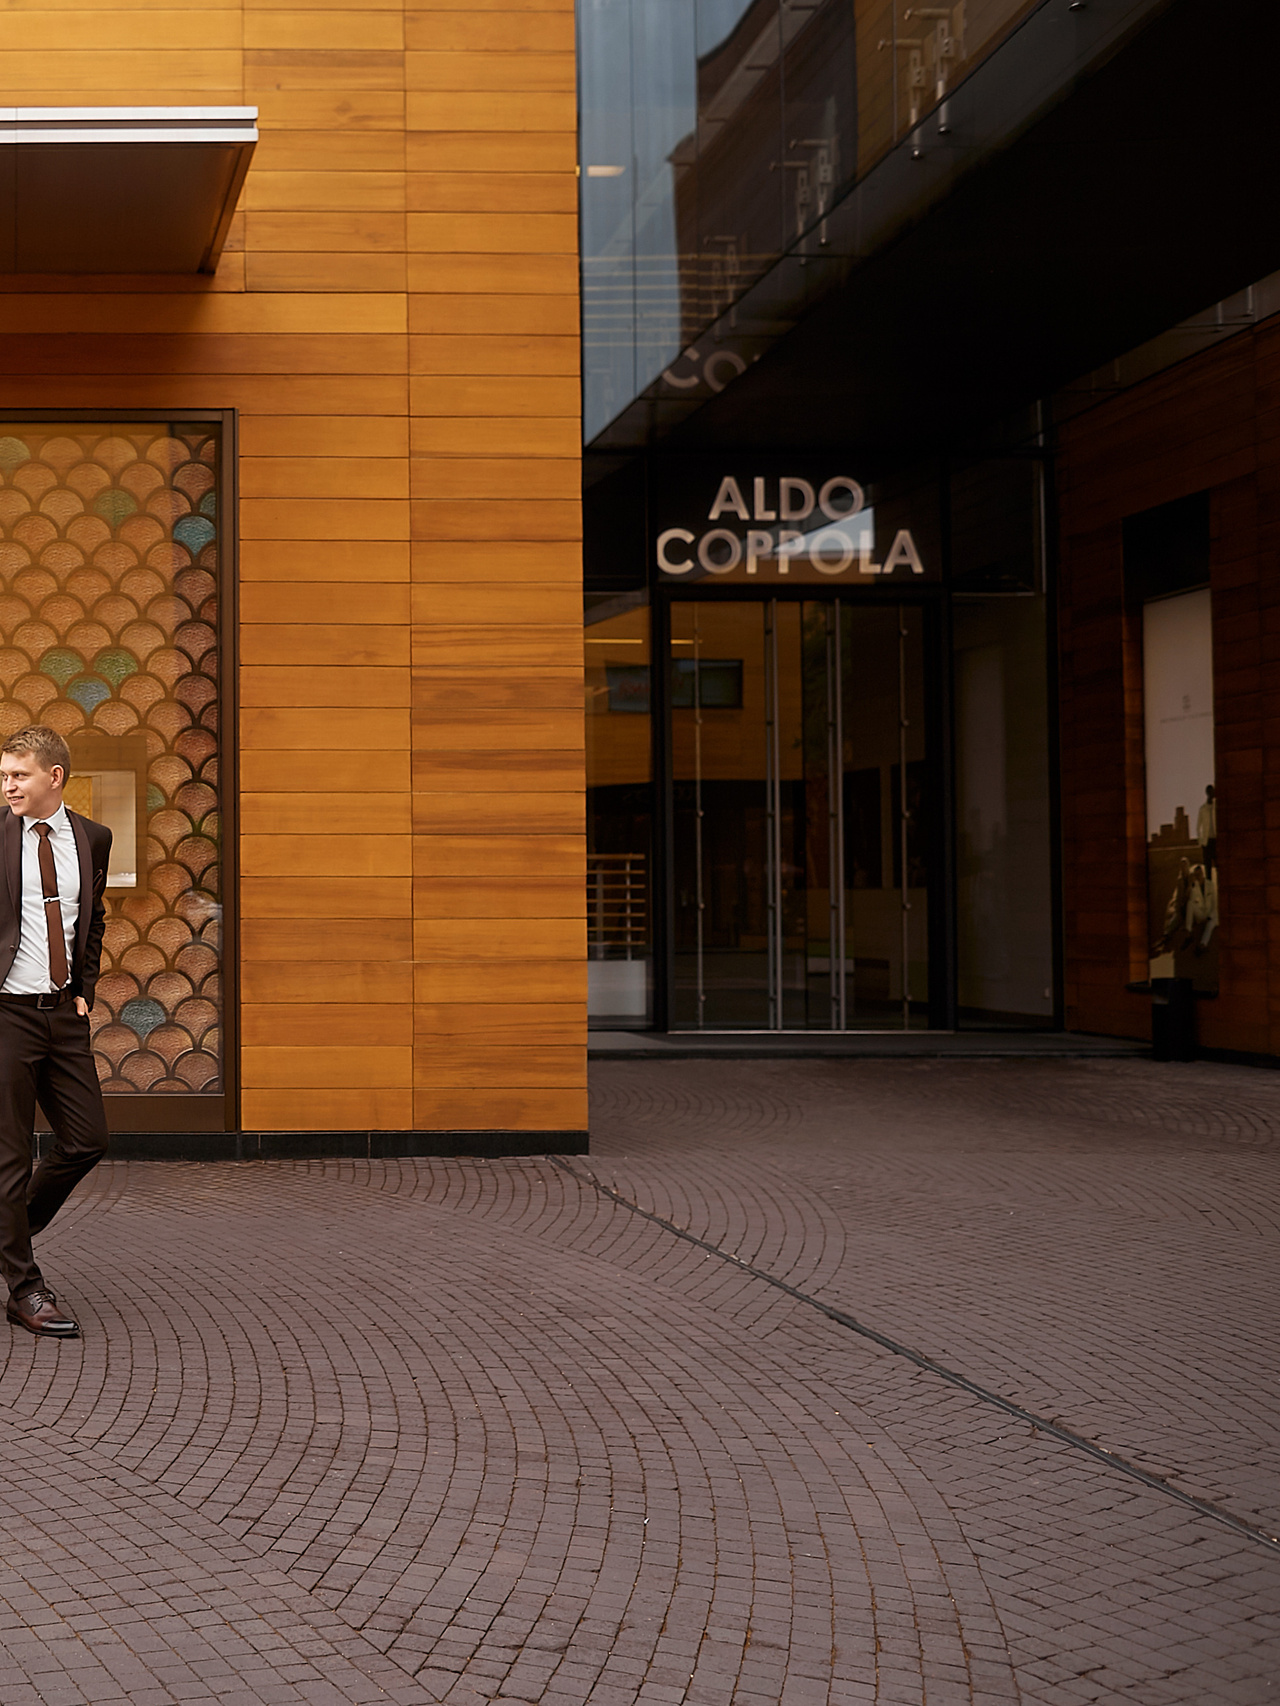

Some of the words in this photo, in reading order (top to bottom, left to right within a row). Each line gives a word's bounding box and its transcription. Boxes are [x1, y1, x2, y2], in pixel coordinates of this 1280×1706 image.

[661, 347, 761, 393] CO
[708, 476, 865, 521] ALDO
[656, 528, 924, 574] COPPOLA
